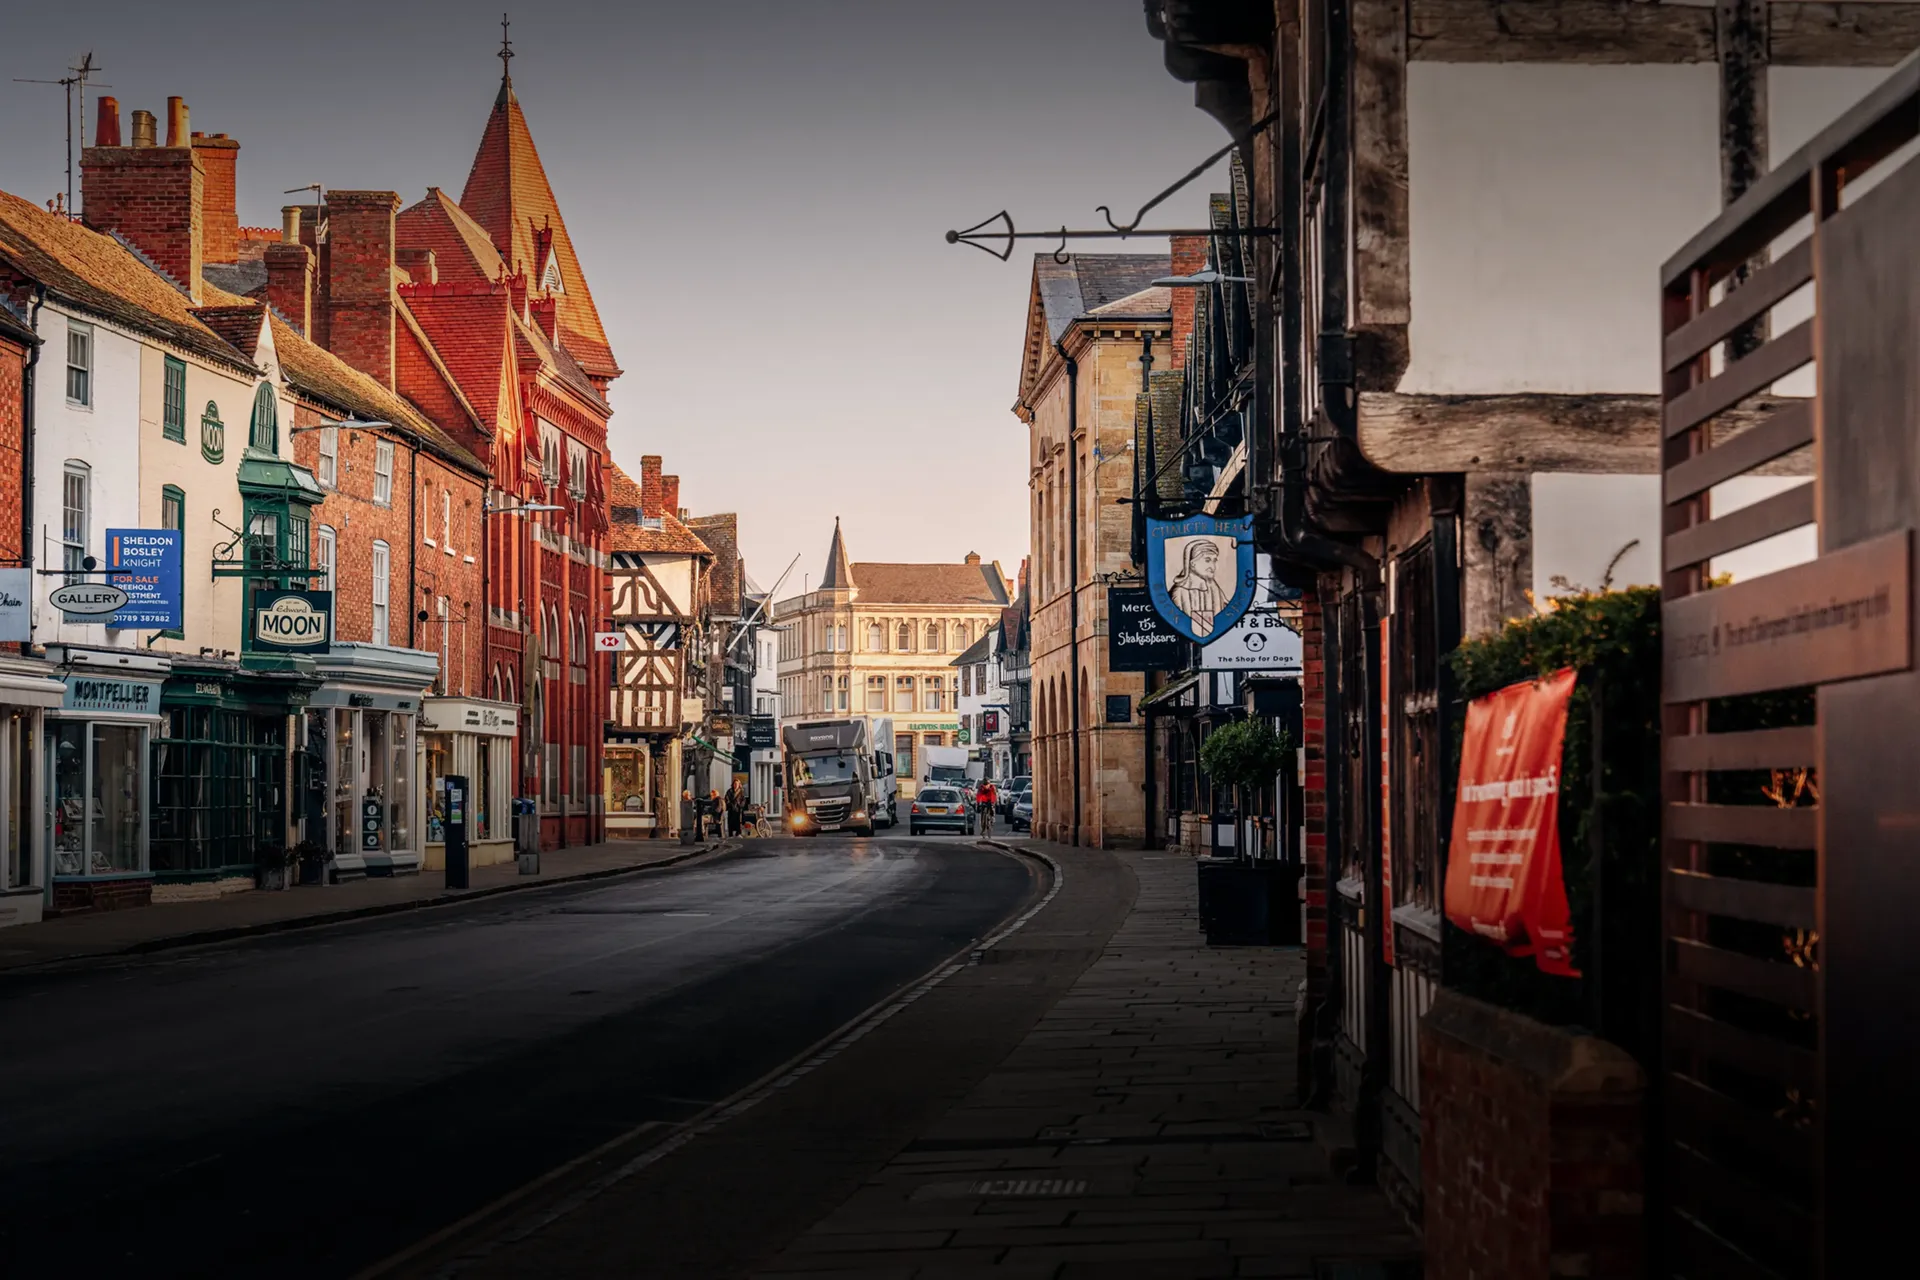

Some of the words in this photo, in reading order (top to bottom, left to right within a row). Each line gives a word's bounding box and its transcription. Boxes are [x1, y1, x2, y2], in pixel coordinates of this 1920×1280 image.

[203, 422, 223, 451] MOON
[123, 536, 173, 546] SHELDON
[123, 547, 164, 556] BOSLEY
[123, 559, 162, 567] KNIGHT
[136, 576, 159, 584] SALE
[58, 594, 120, 604] GALLERY
[128, 592, 162, 600] ESTMENT
[276, 605, 308, 614] Edward
[1121, 604, 1155, 613] Merc
[140, 615, 170, 623] 387882
[1249, 617, 1261, 629] &
[263, 615, 322, 636] MOON
[1117, 632, 1177, 646] Shakespeare
[1235, 656, 1256, 664] Shop
[1258, 655, 1271, 663] for
[1273, 655, 1294, 664] Dogs
[75, 680, 149, 703] MONTPELLIER
[909, 723, 939, 731] LLOYDS
